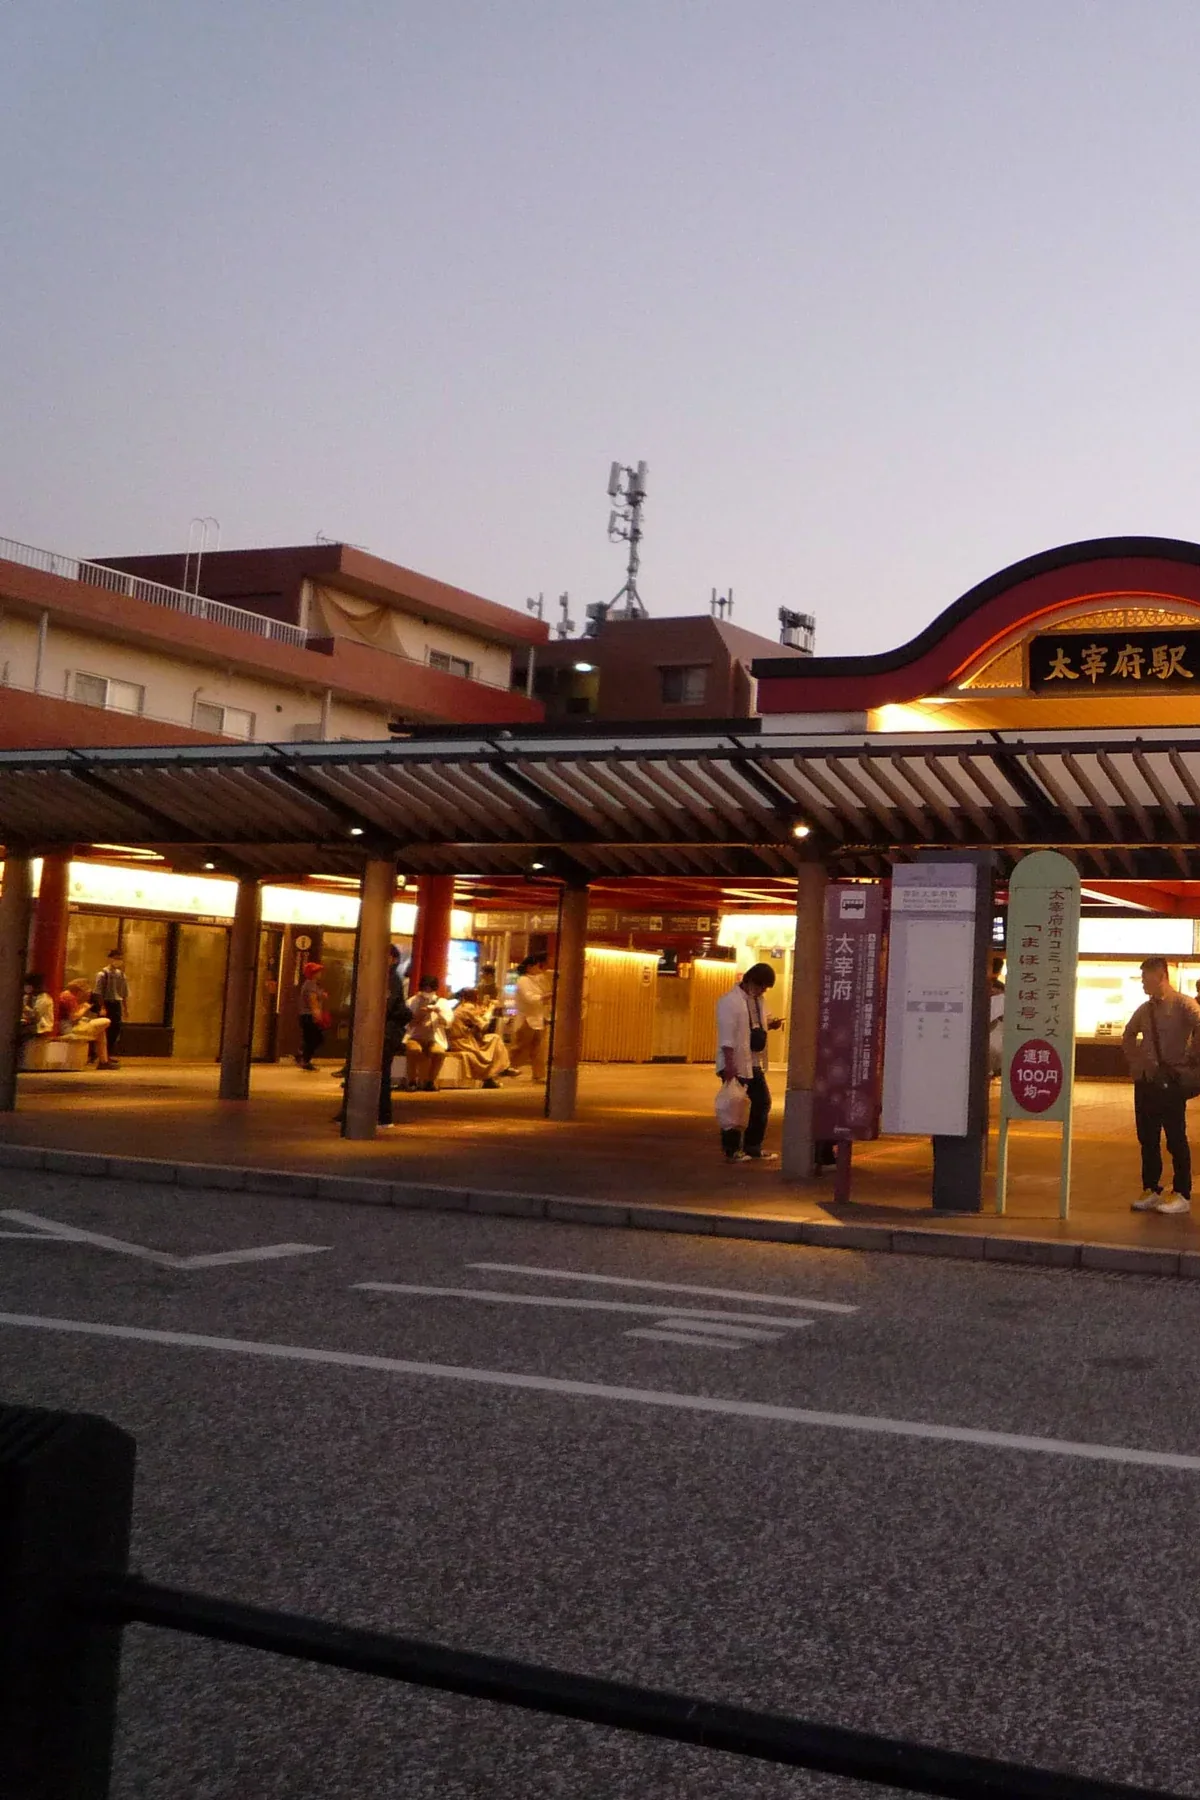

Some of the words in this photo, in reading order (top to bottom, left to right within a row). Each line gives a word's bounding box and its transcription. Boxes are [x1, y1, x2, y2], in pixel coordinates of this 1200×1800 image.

[1043, 643, 1194, 684] 太宰府駅
[832, 932, 855, 1001] 太宰府
[1045, 889, 1065, 1038] 太宰府市コミュニティバス
[1023, 1049, 1051, 1065] 運賃
[1017, 1068, 1058, 1084] 100円
[1023, 1084, 1051, 1099] 均一
